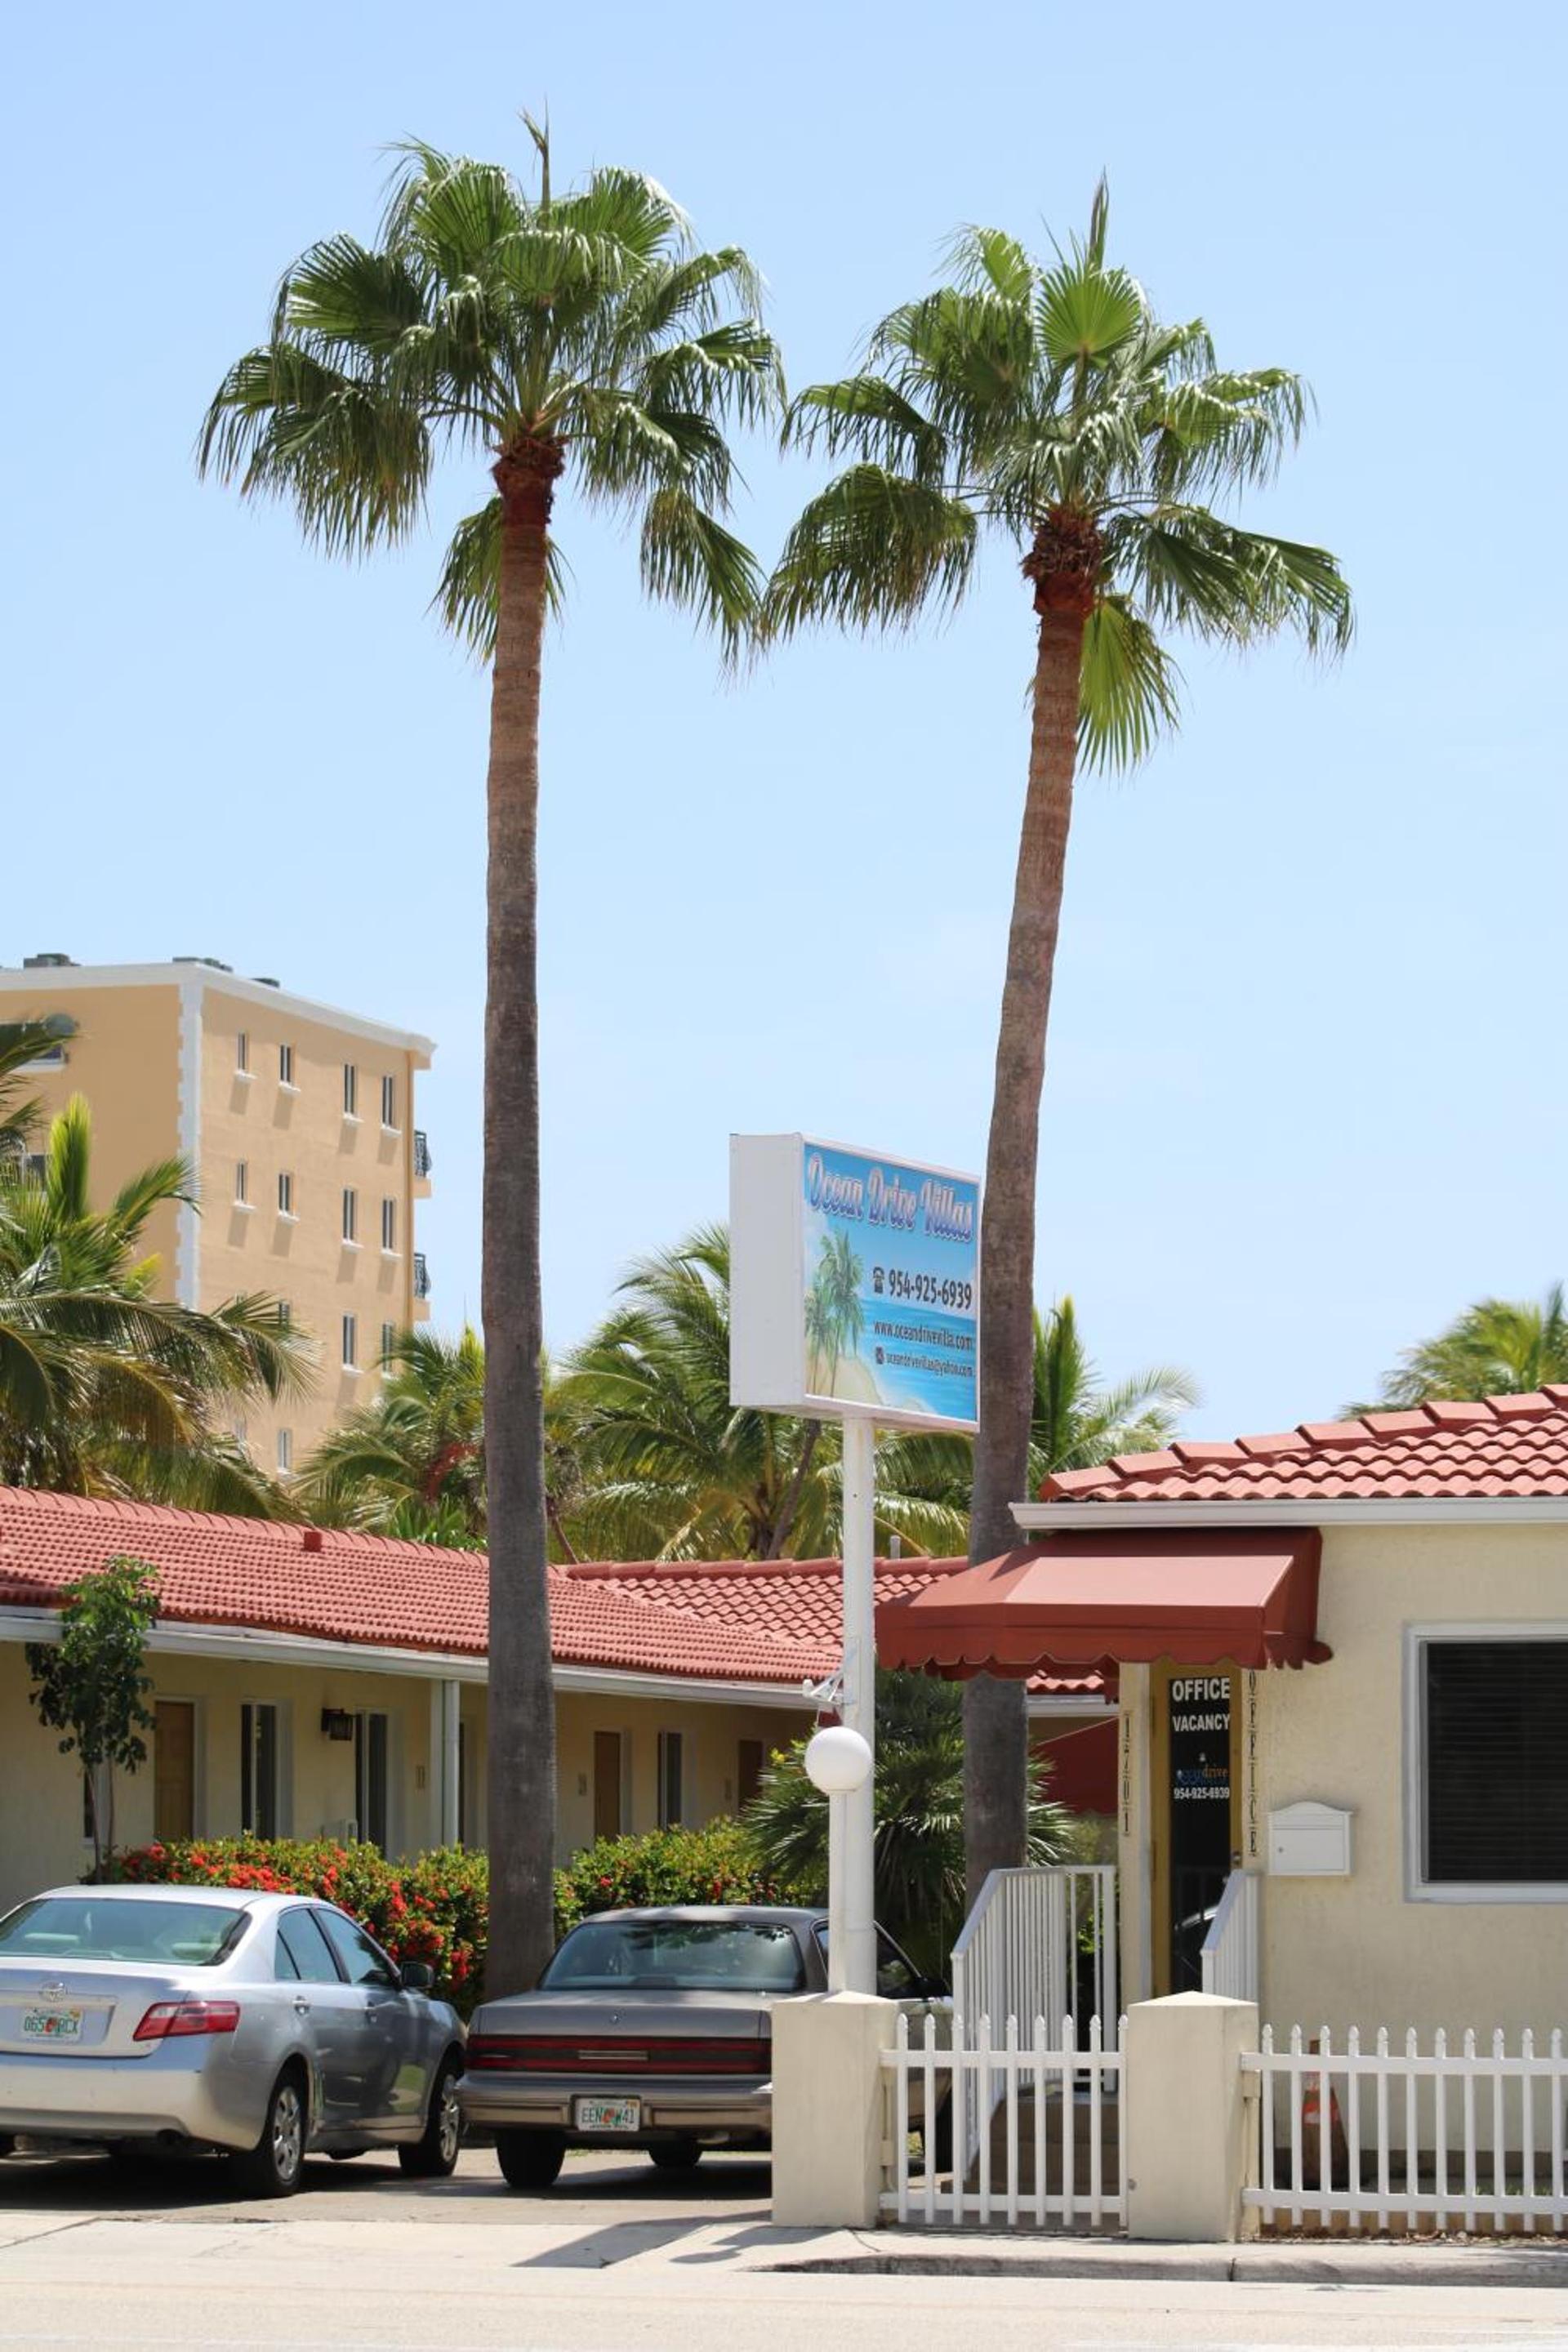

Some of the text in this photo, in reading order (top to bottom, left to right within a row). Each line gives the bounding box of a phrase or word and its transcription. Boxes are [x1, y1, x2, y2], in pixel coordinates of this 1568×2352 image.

[808, 1153, 973, 1242] Ocean Drive Villas
[889, 1269, 972, 1310] 954-925-6939
[1172, 1677, 1230, 1701] OFFICE
[1173, 1714, 1230, 1731] VACANCY
